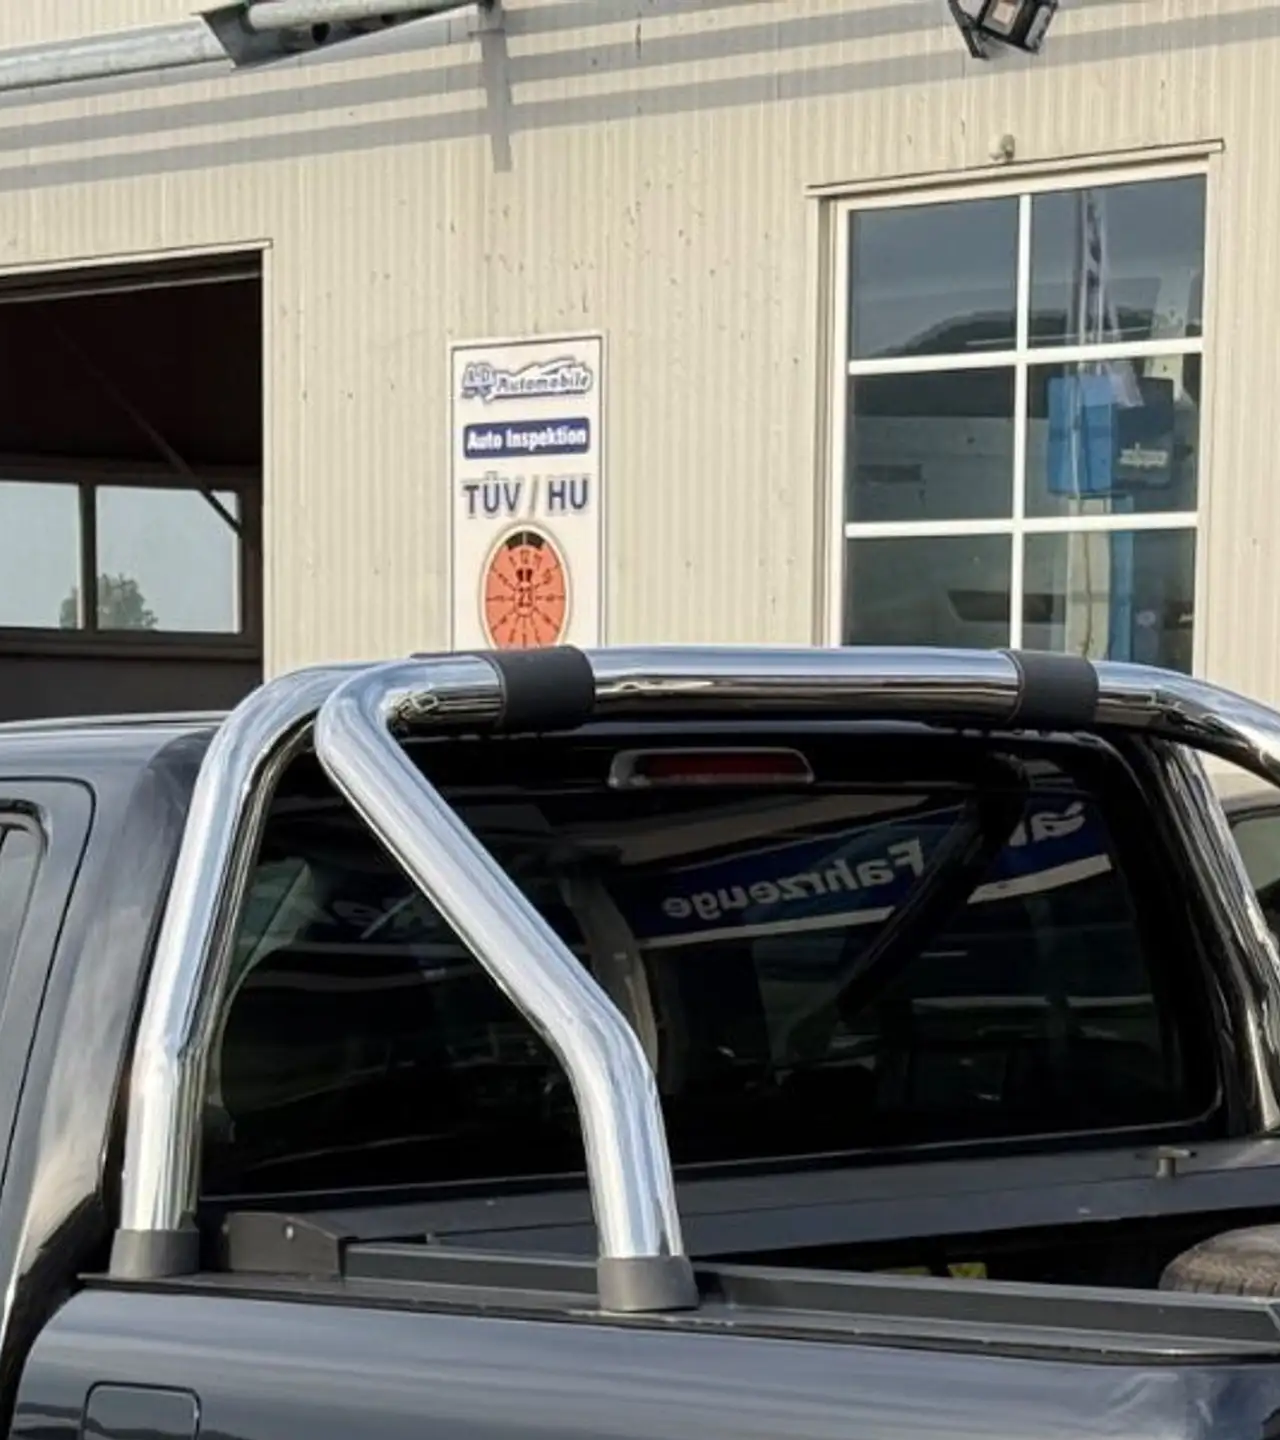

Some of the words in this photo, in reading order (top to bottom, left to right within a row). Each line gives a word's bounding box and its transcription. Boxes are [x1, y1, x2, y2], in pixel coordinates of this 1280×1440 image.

[467, 432, 503, 451] Auto
[506, 426, 587, 451] Inspektion
[463, 472, 522, 514] TÜV
[548, 479, 588, 510] HU
